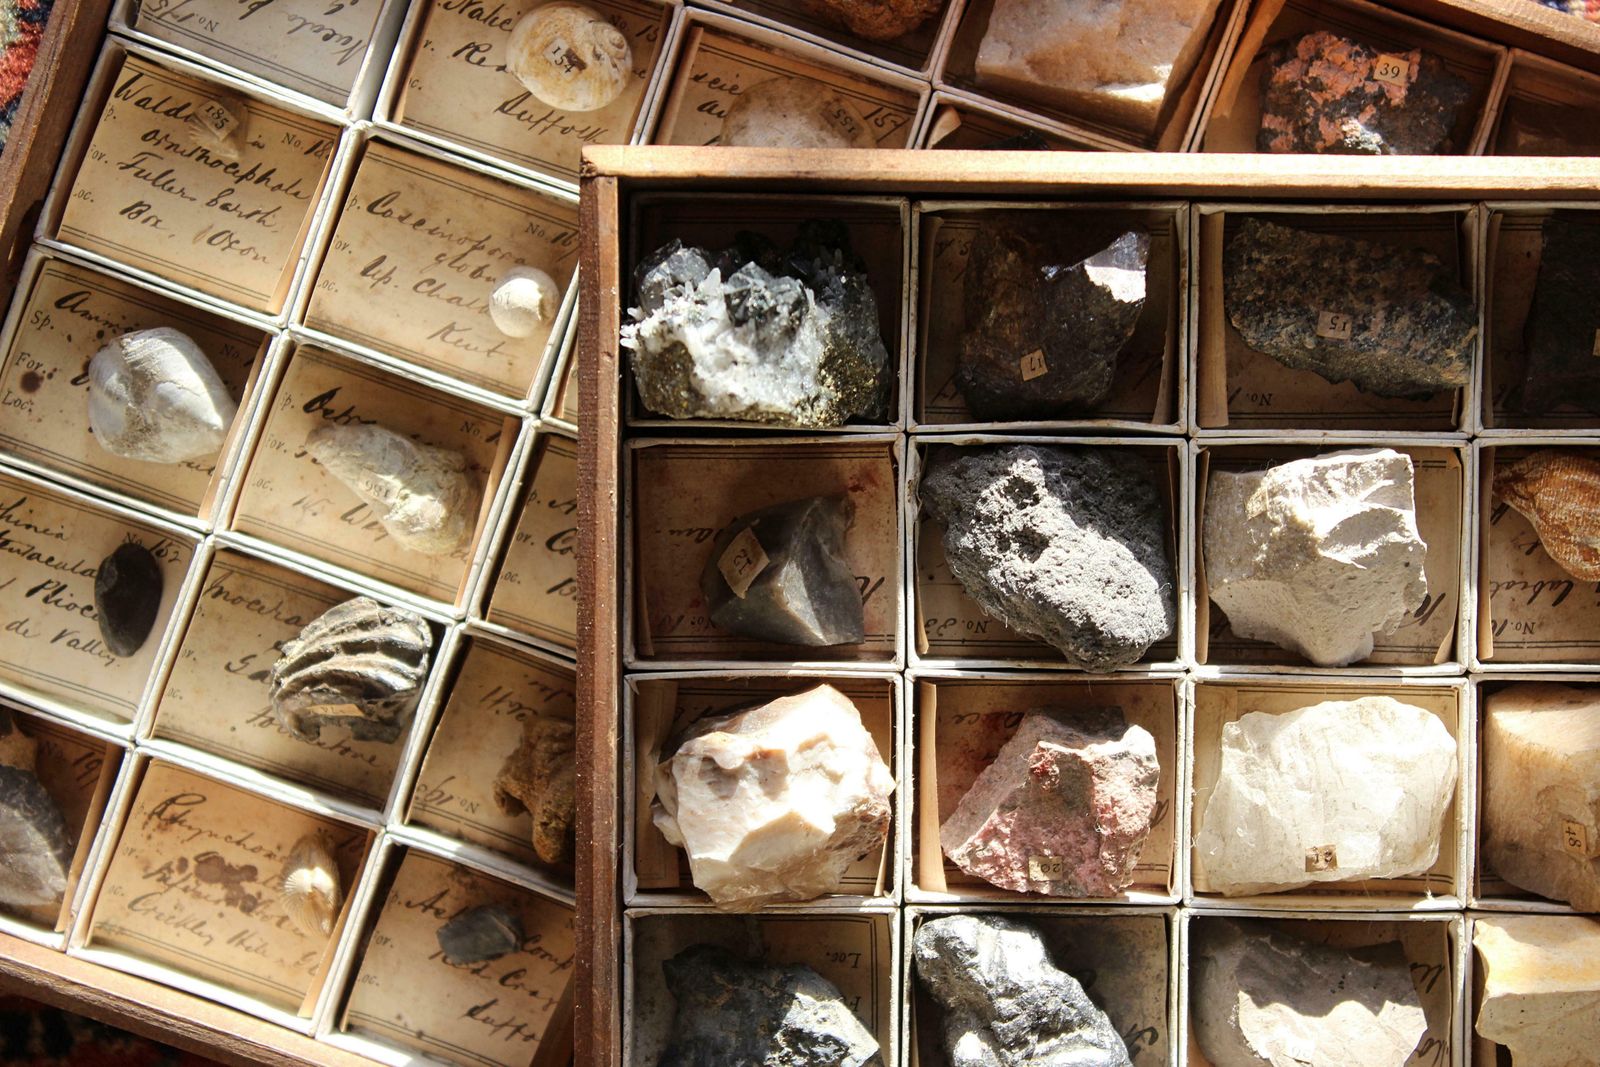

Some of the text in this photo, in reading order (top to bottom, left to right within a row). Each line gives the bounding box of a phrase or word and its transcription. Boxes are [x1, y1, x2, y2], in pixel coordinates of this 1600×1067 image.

[552, 46, 573, 74] 154
[1379, 62, 1401, 79] 39
[203, 106, 227, 130] 185
[281, 133, 303, 148] No.
[30, 312, 54, 331] Sp.
[1329, 315, 1347, 331] 15
[15, 352, 46, 374] For.
[1029, 357, 1042, 372] 17
[962, 620, 988, 634] No.
[1511, 621, 1535, 635] No.
[1566, 825, 1582, 849] 48
[826, 952, 861, 970] Loc.
